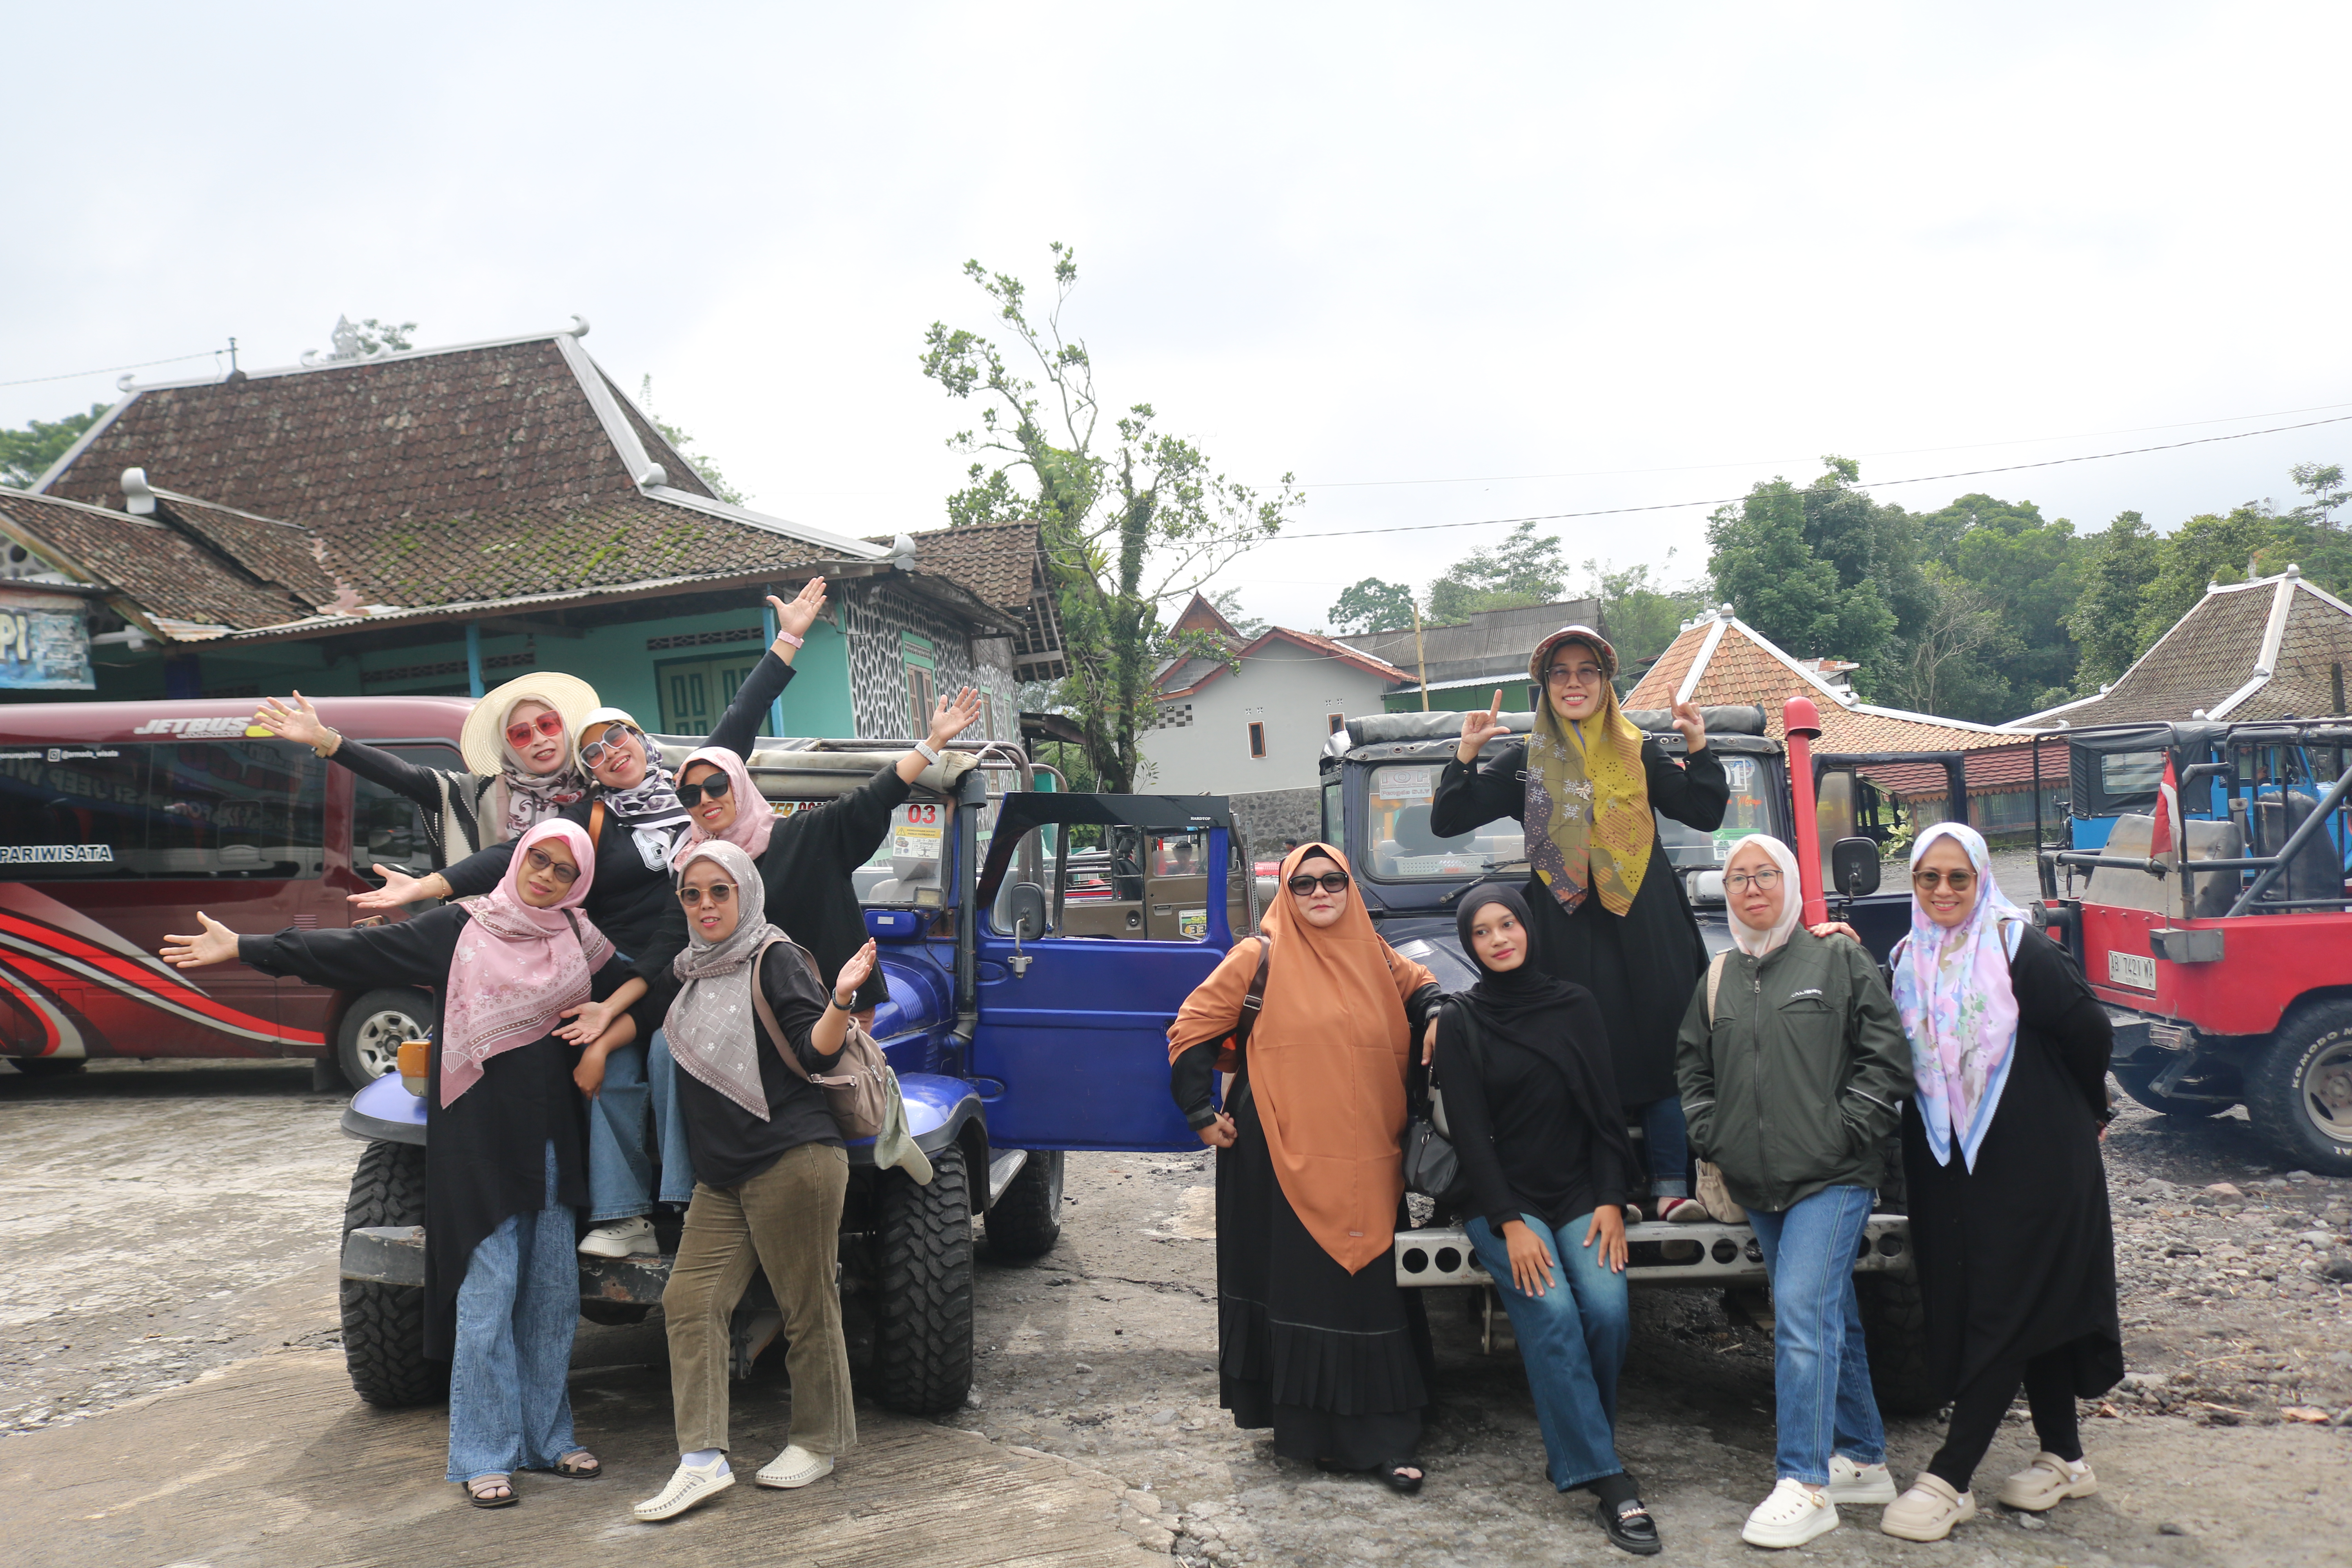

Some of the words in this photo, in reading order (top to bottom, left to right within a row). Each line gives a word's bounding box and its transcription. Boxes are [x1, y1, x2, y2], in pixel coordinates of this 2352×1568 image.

[133, 717, 252, 734] JETBUS
[908, 804, 936, 824] 03
[0, 845, 113, 863] PARIWISATA
[2110, 953, 2119, 971] AB
[2123, 957, 2140, 976] 7421
[2143, 960, 2153, 979] WA
[2292, 1031, 2338, 1089] KOMODO
